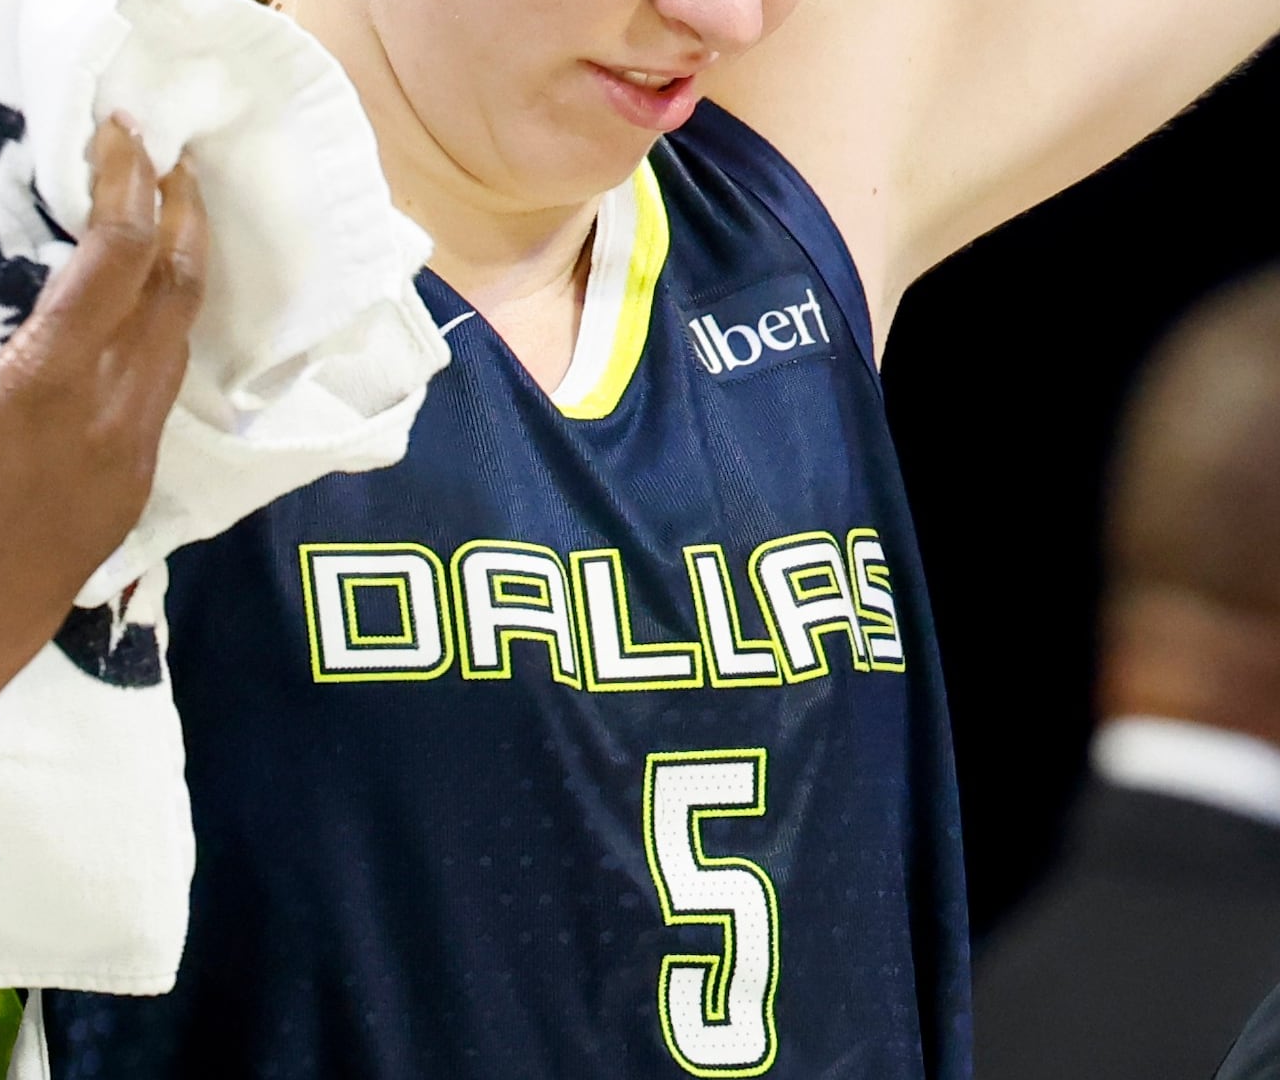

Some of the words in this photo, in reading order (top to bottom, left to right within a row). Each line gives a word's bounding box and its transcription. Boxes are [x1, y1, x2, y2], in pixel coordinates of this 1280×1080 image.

[688, 288, 831, 375] lbert
[298, 528, 906, 693] DALLAS
[642, 747, 780, 1078] 5
